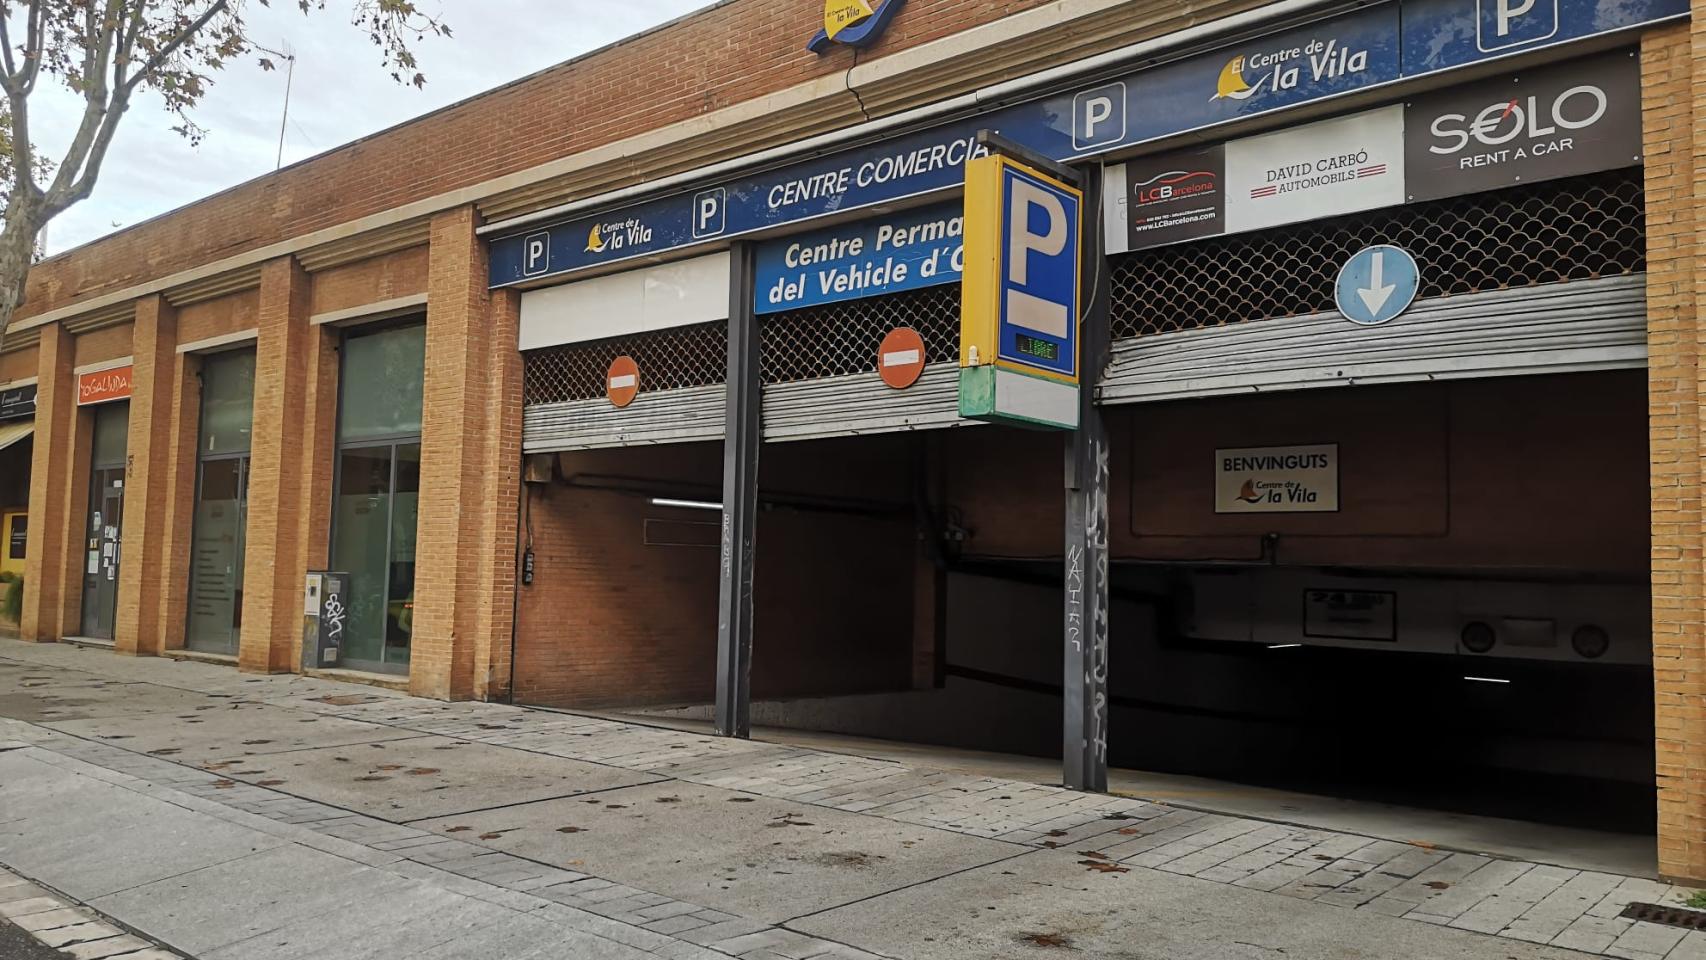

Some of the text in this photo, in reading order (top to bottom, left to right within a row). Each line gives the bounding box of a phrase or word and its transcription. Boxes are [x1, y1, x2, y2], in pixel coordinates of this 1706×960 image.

[1497, 0, 1536, 36] P
[1231, 39, 1324, 74] El Centre de
[1271, 39, 1368, 91] la Vila
[1086, 96, 1112, 138] P
[1267, 148, 1368, 182] DAVID CARBÓ
[1460, 138, 1573, 169] RENT A CAR
[768, 167, 851, 208] CENTRE
[1140, 182, 1213, 202] LCBarcelona
[1279, 170, 1355, 193] AUTOMOBILS
[602, 222, 624, 233] Centre
[625, 218, 635, 227] de
[700, 198, 717, 229] P
[1136, 212, 1216, 231] www.LCBarcelona.com
[611, 219, 652, 250] la Vila
[1009, 177, 1067, 286] P
[529, 240, 543, 268] P
[785, 236, 863, 268] Centre
[769, 273, 806, 303] del
[819, 257, 907, 295] Vehicle
[1223, 454, 1328, 472] BENVINGUTS
[1256, 481, 1283, 489] Centre
[1268, 483, 1317, 503] la Vila
